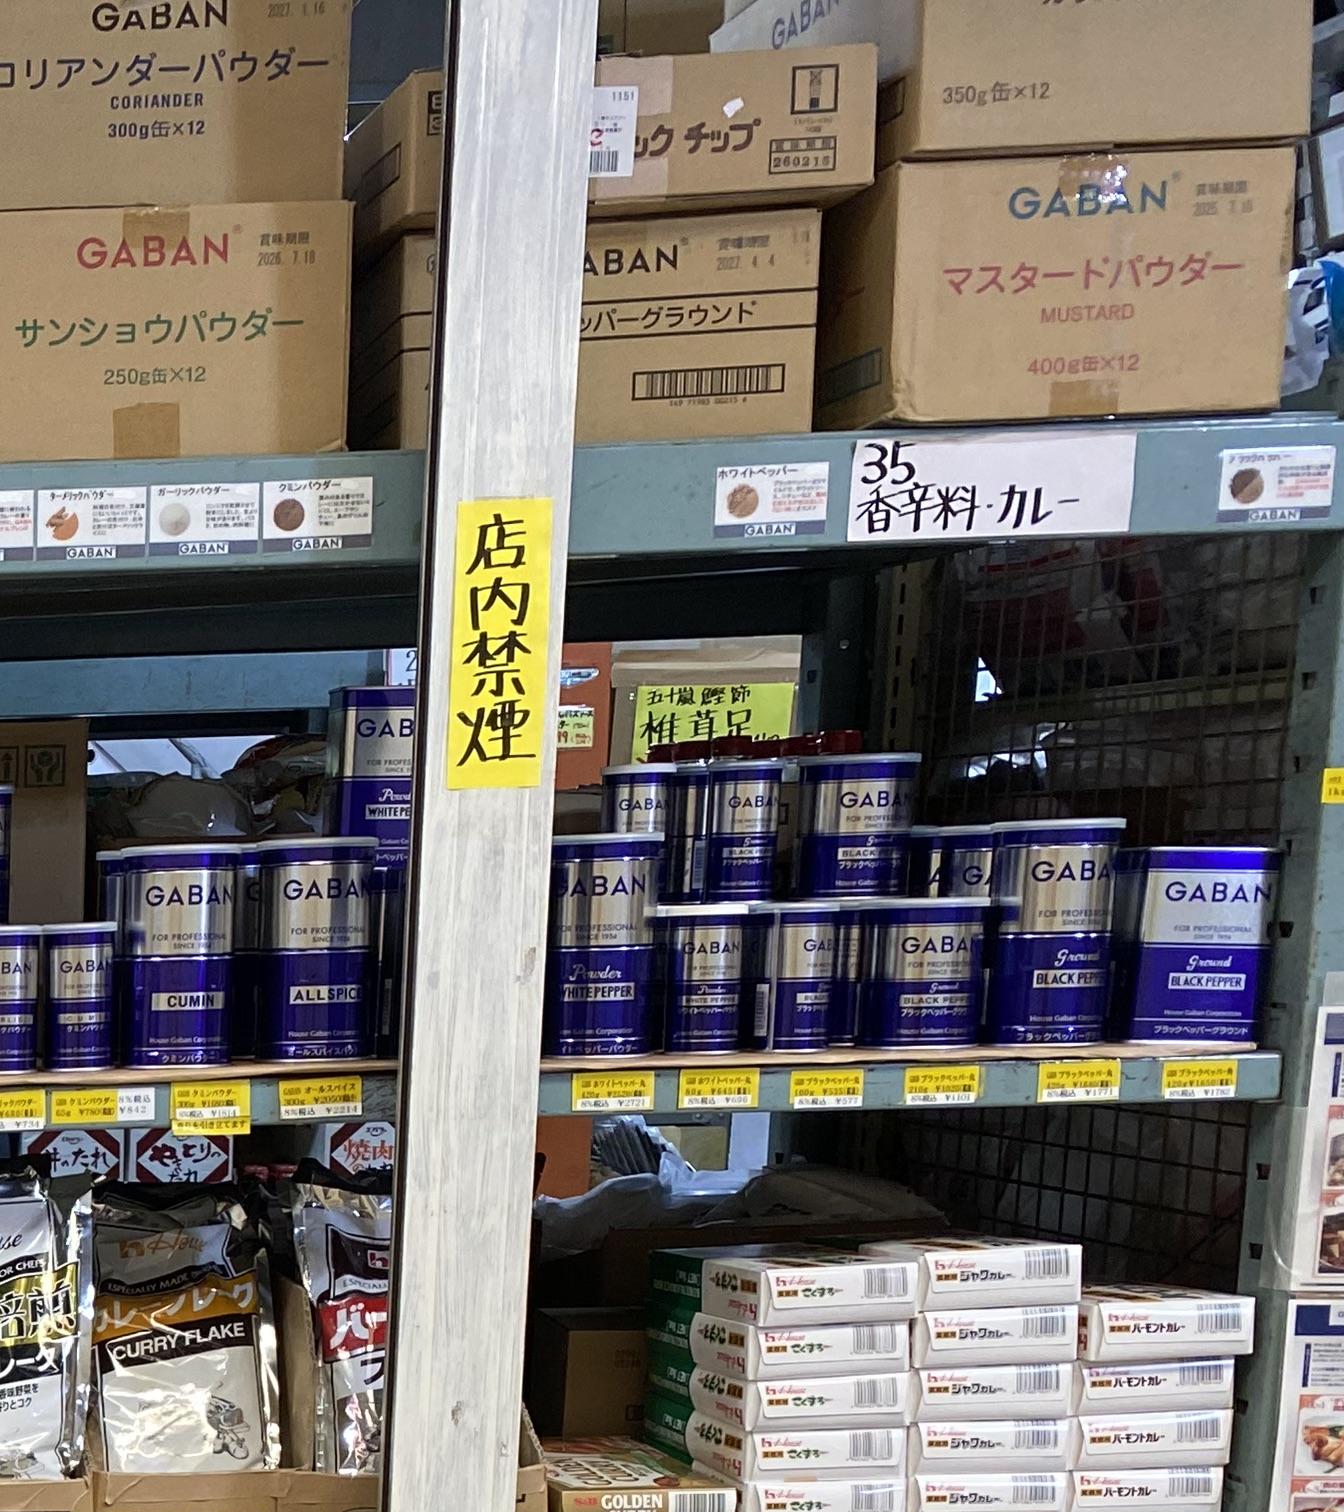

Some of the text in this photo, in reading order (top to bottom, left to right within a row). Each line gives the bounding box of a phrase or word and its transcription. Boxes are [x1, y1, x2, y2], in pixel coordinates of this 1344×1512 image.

[91, 0, 228, 32] GABAN
[109, 92, 204, 111] CORIANDER
[942, 83, 988, 107] 350g
[107, 119, 206, 140] 300g缶×12
[1008, 180, 1168, 220] GABAN
[76, 232, 230, 270] GABAN
[942, 250, 1246, 296] マスタードパウダー
[1039, 302, 1136, 325] MUSTARD
[14, 306, 305, 349] サンショウパウダー
[103, 365, 207, 387] 250g缶×12
[1026, 353, 1141, 377] 400g缶×12
[860, 442, 918, 485] 35
[455, 512, 537, 768] 店内禁煙
[568, 963, 622, 982] Powder
[166, 994, 215, 1010] CUMIN
[113, 1321, 246, 1362] CURRY FLAKE
[601, 1493, 663, 1511] GOLDEN
